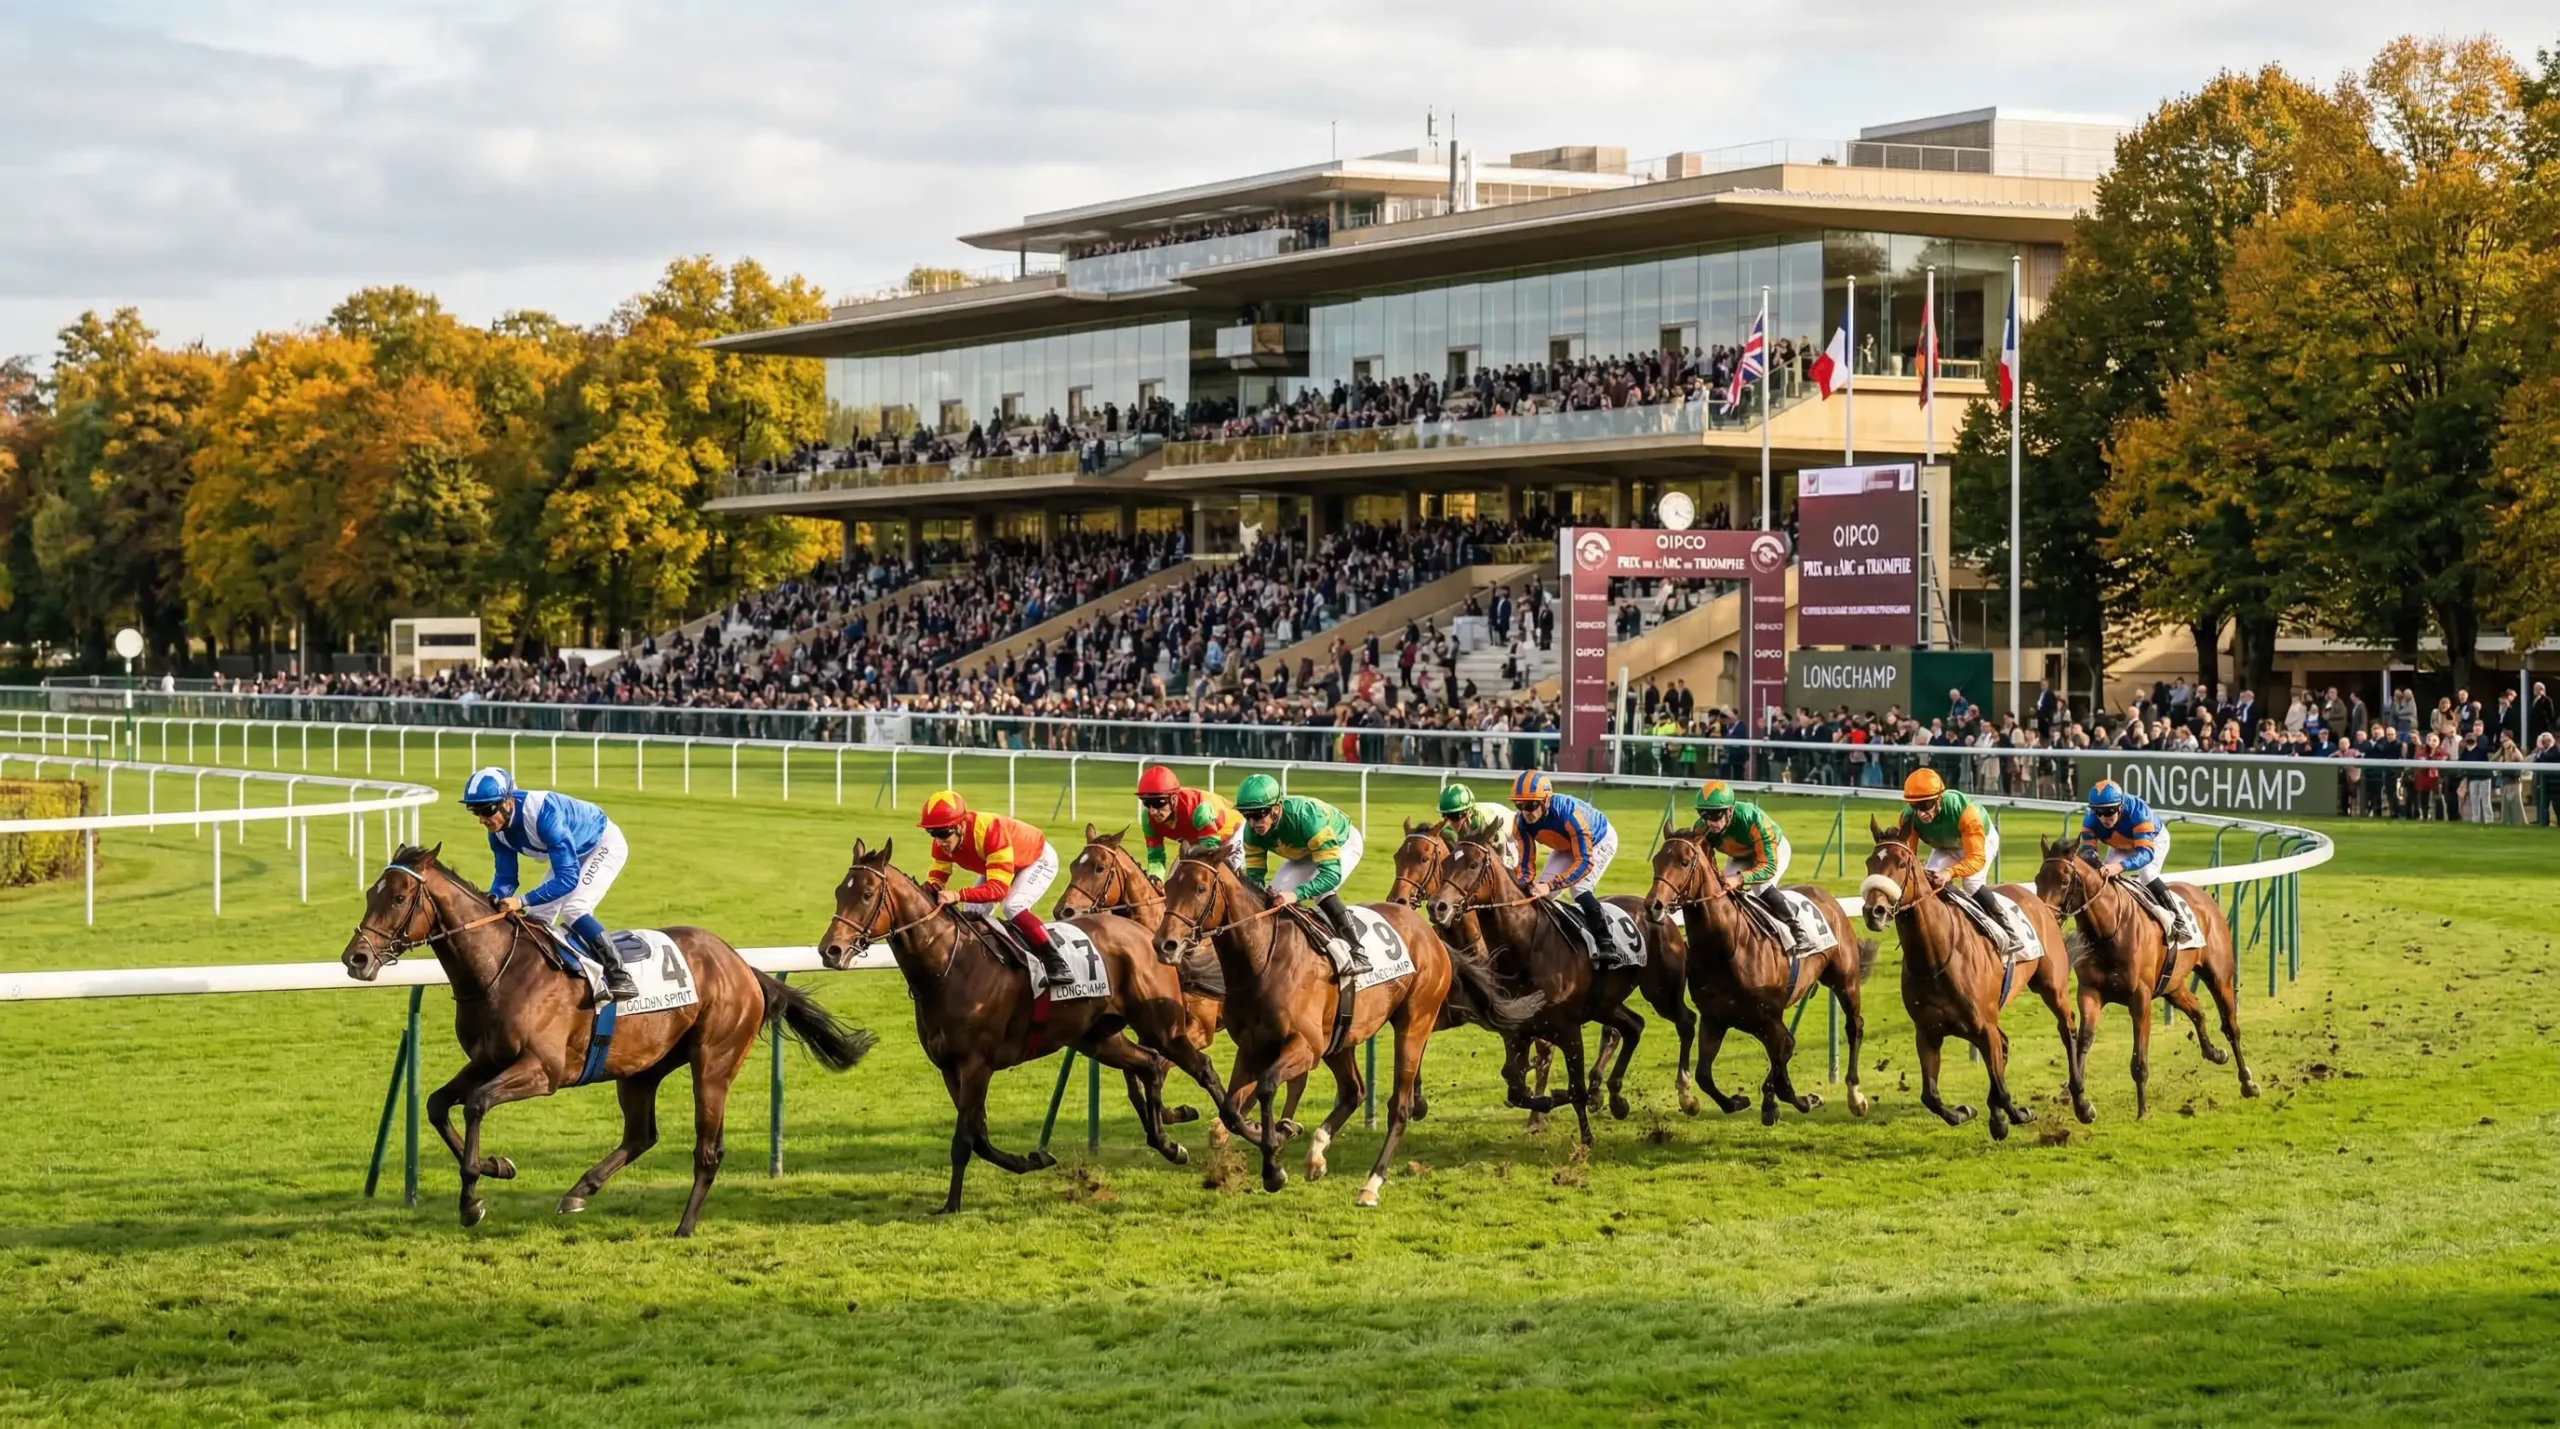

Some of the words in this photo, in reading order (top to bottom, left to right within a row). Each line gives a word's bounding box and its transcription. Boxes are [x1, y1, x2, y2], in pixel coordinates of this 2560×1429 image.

[1833, 524, 1879, 547] QIPCO
[1803, 665, 1897, 688] LONGCHAMP
[1373, 922, 1402, 960] 9
[1618, 916, 1642, 953] 9
[661, 945, 688, 988] 4
[1072, 939, 1099, 981] 7
